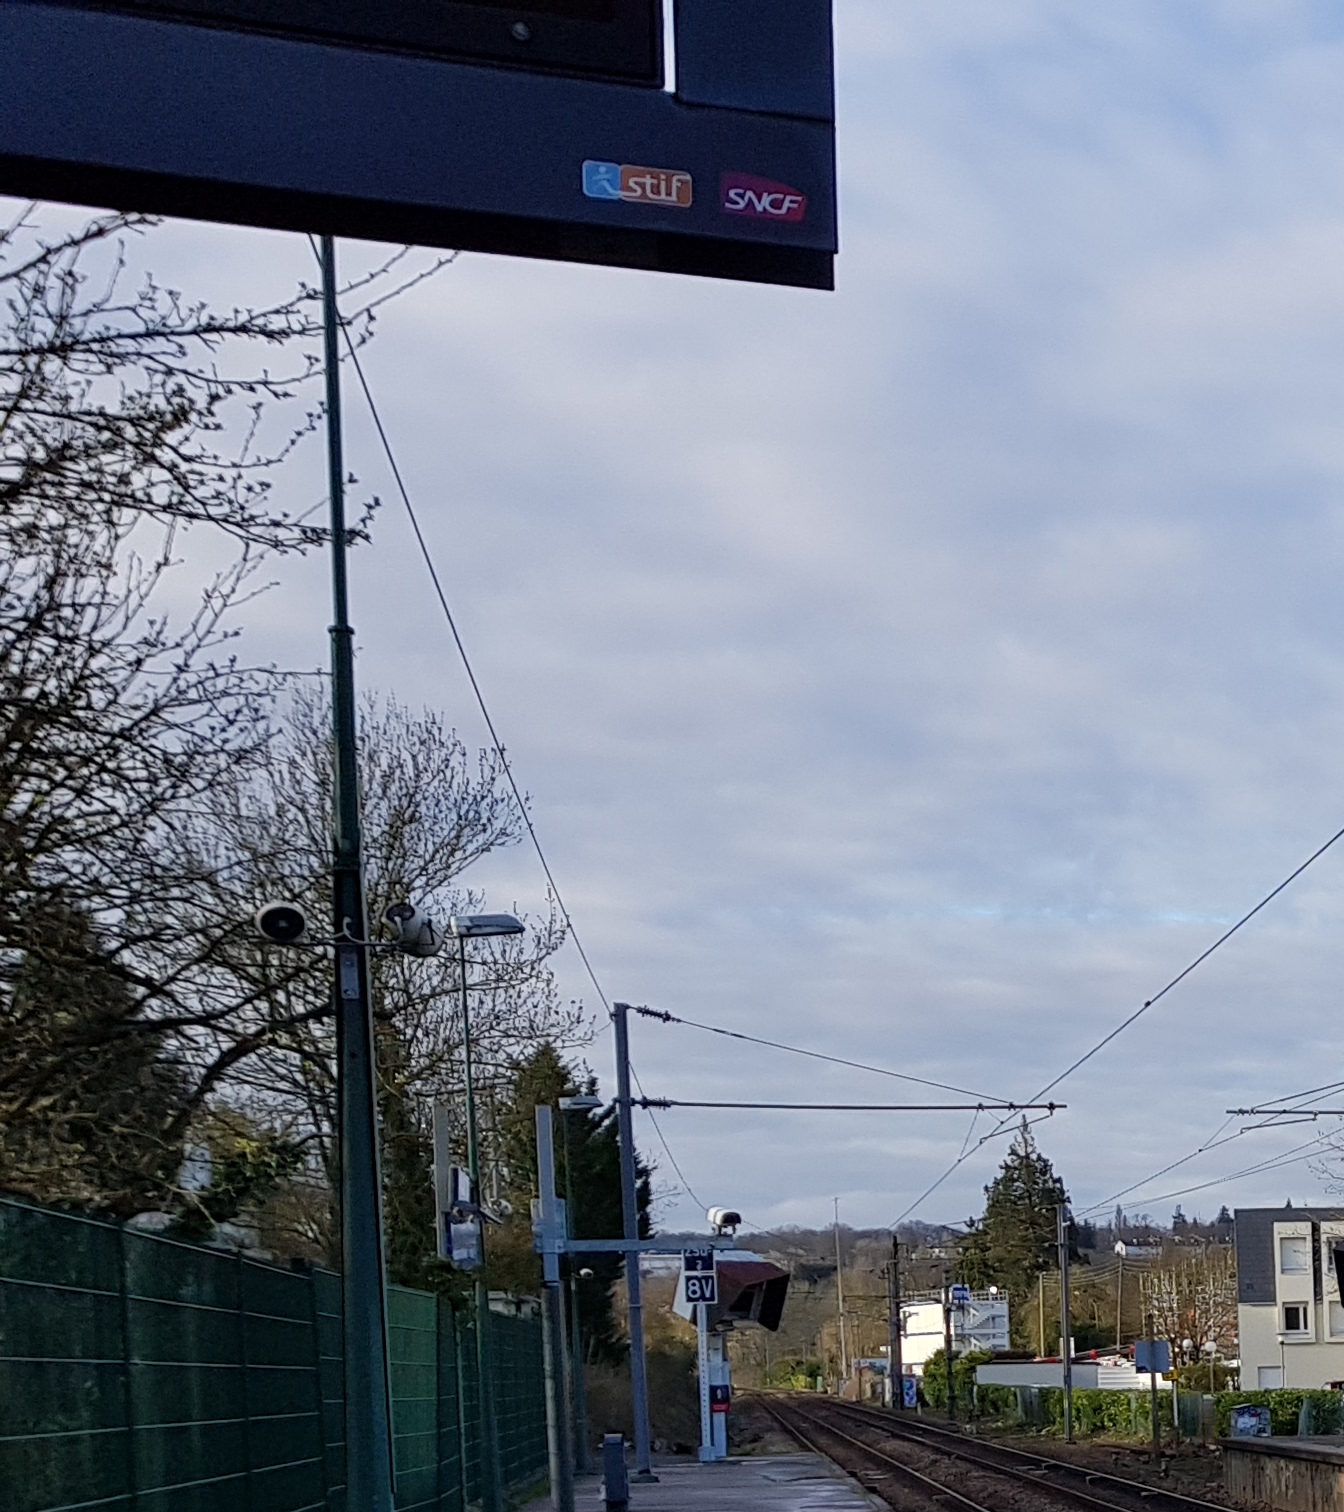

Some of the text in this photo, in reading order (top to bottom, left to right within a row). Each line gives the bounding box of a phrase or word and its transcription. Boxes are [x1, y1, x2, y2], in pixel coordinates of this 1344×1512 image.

[627, 173, 692, 202] stif
[724, 187, 803, 215] SNCF
[687, 1278, 713, 1298] 8V
